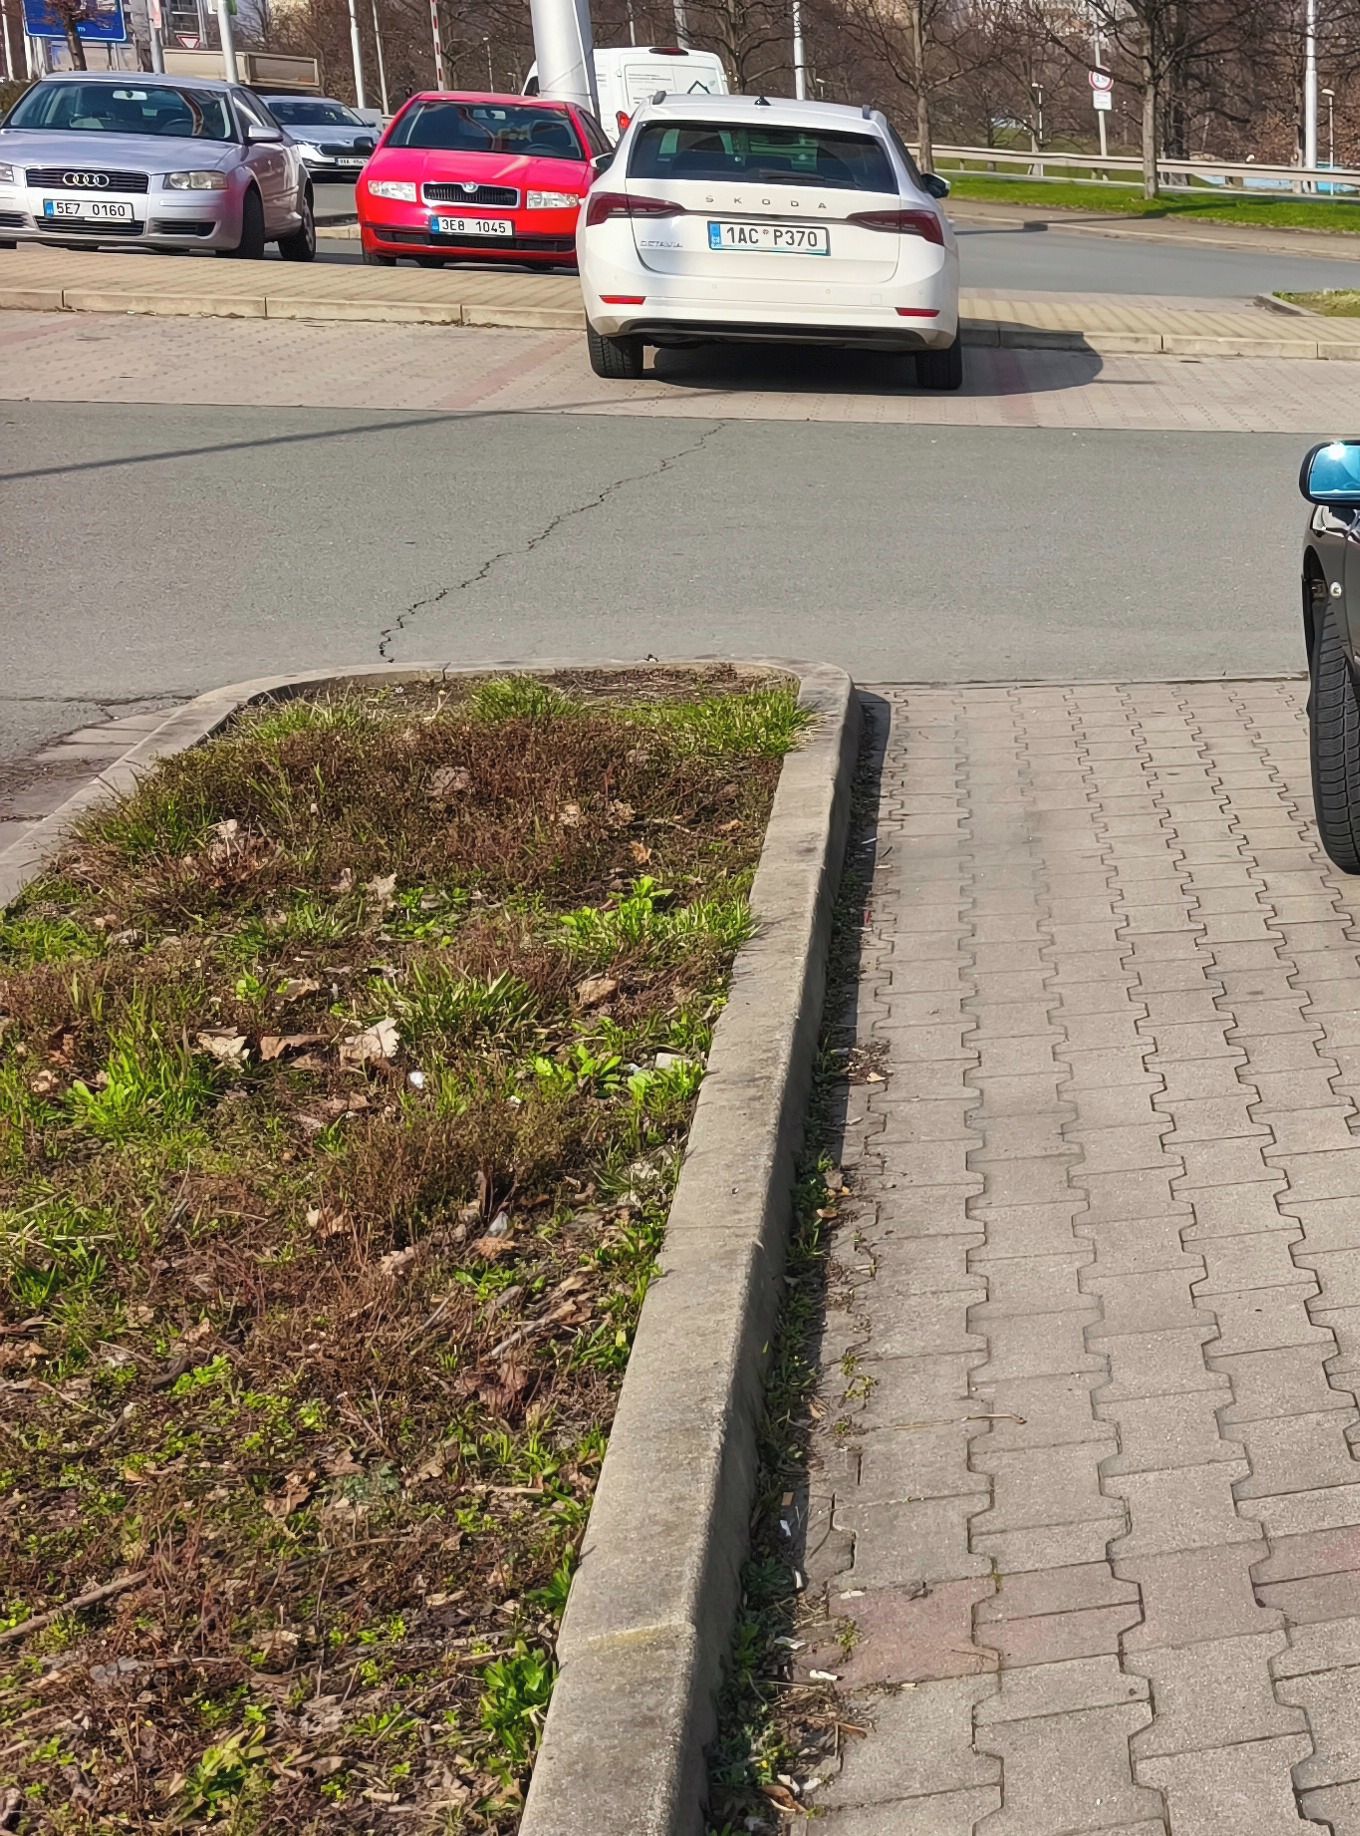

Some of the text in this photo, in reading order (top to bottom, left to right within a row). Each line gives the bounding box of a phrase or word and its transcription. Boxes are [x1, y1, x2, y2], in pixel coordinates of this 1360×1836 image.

[56, 202, 125, 216] 5E7 0160
[442, 219, 506, 233] 3E8 1045
[726, 226, 818, 247] 1AC P370
